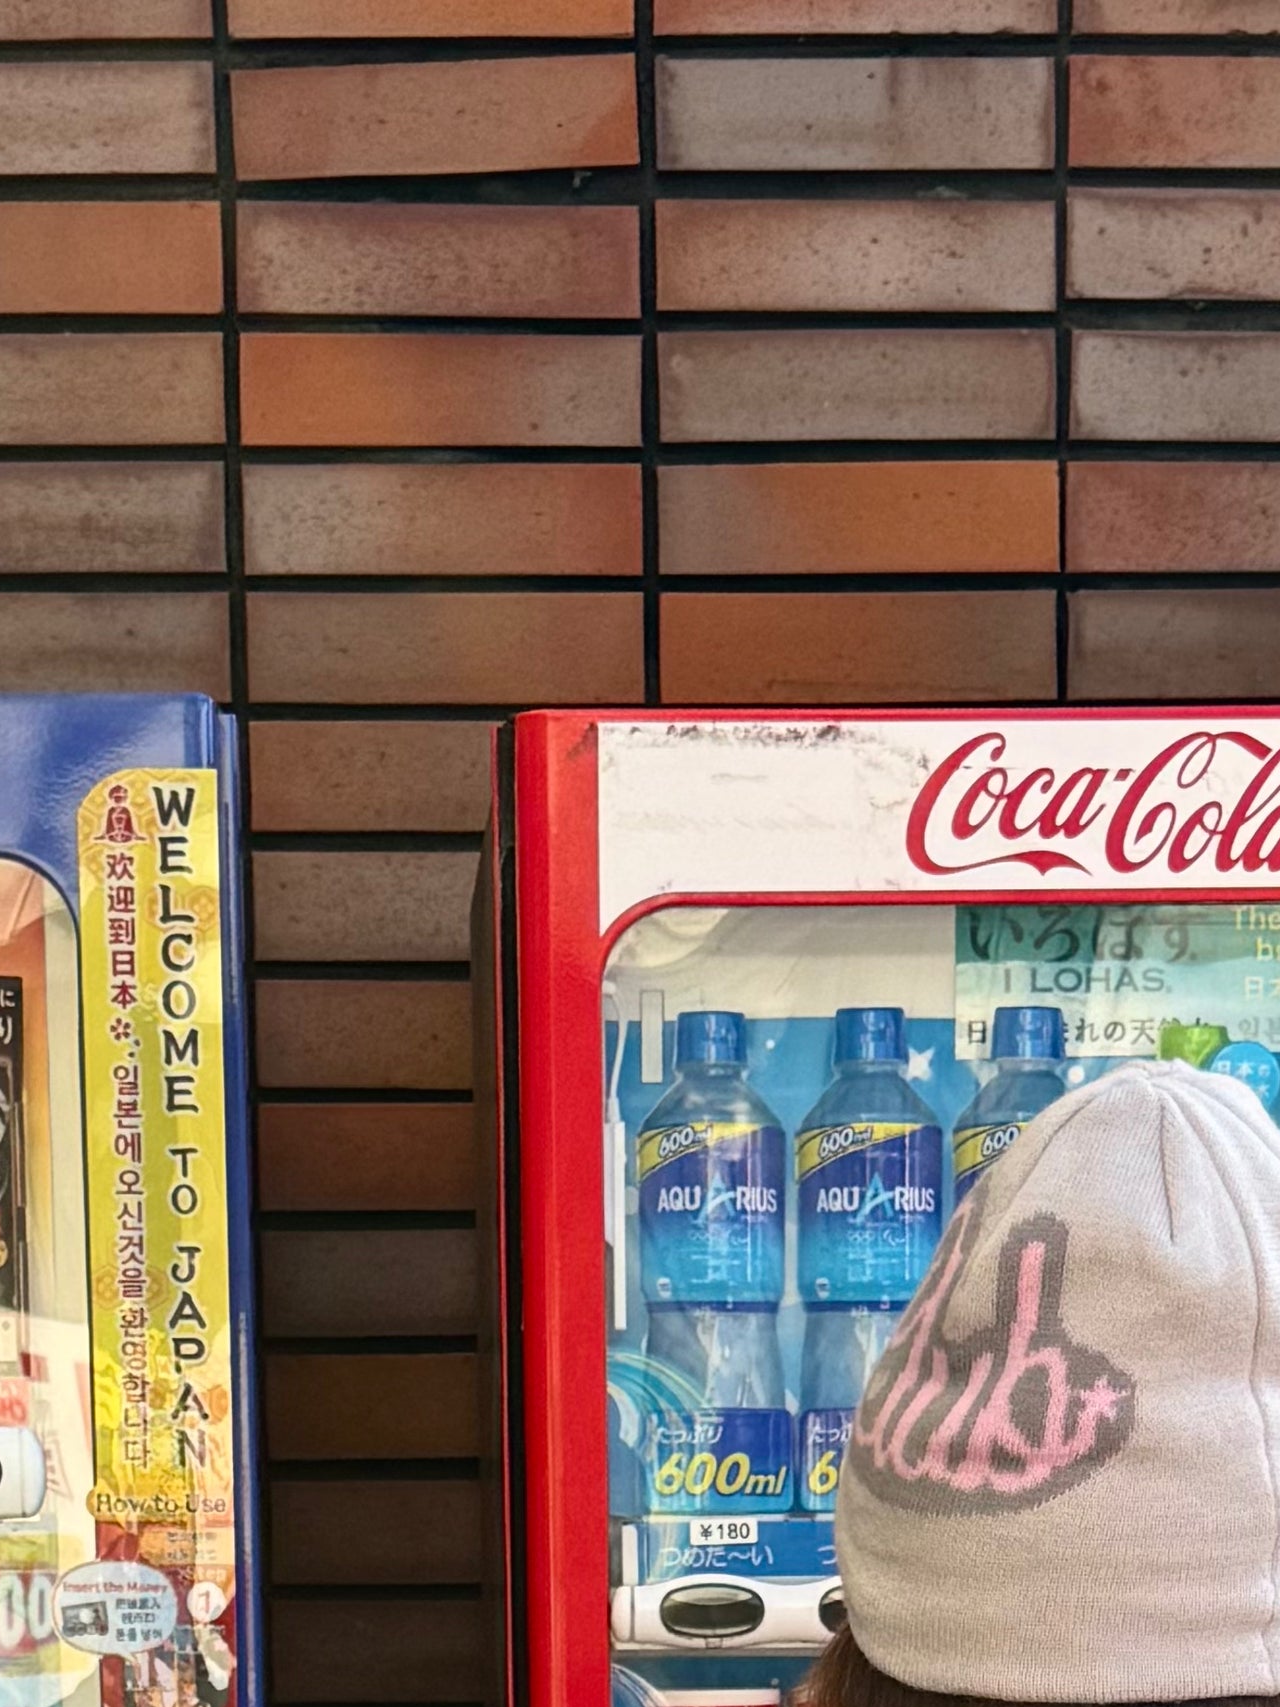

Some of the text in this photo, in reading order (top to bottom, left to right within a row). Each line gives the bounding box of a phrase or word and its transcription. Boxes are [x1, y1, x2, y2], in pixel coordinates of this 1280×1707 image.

[106, 852, 137, 1009] 欢迎到日本
[152, 786, 209, 1469] WELCOME TO JAPAN
[657, 1172, 778, 1223] AQUARIUS
[817, 1171, 935, 1223] AQUARIUS
[113, 1065, 150, 1470] 일본에 오신것을 환영합니다
[656, 1423, 721, 1446] たっぷり
[655, 1450, 787, 1499] 600ml
[96, 1493, 227, 1513] How to Use
[698, 1521, 750, 1541] ¥180
[63, 1582, 99, 1593] Insert
